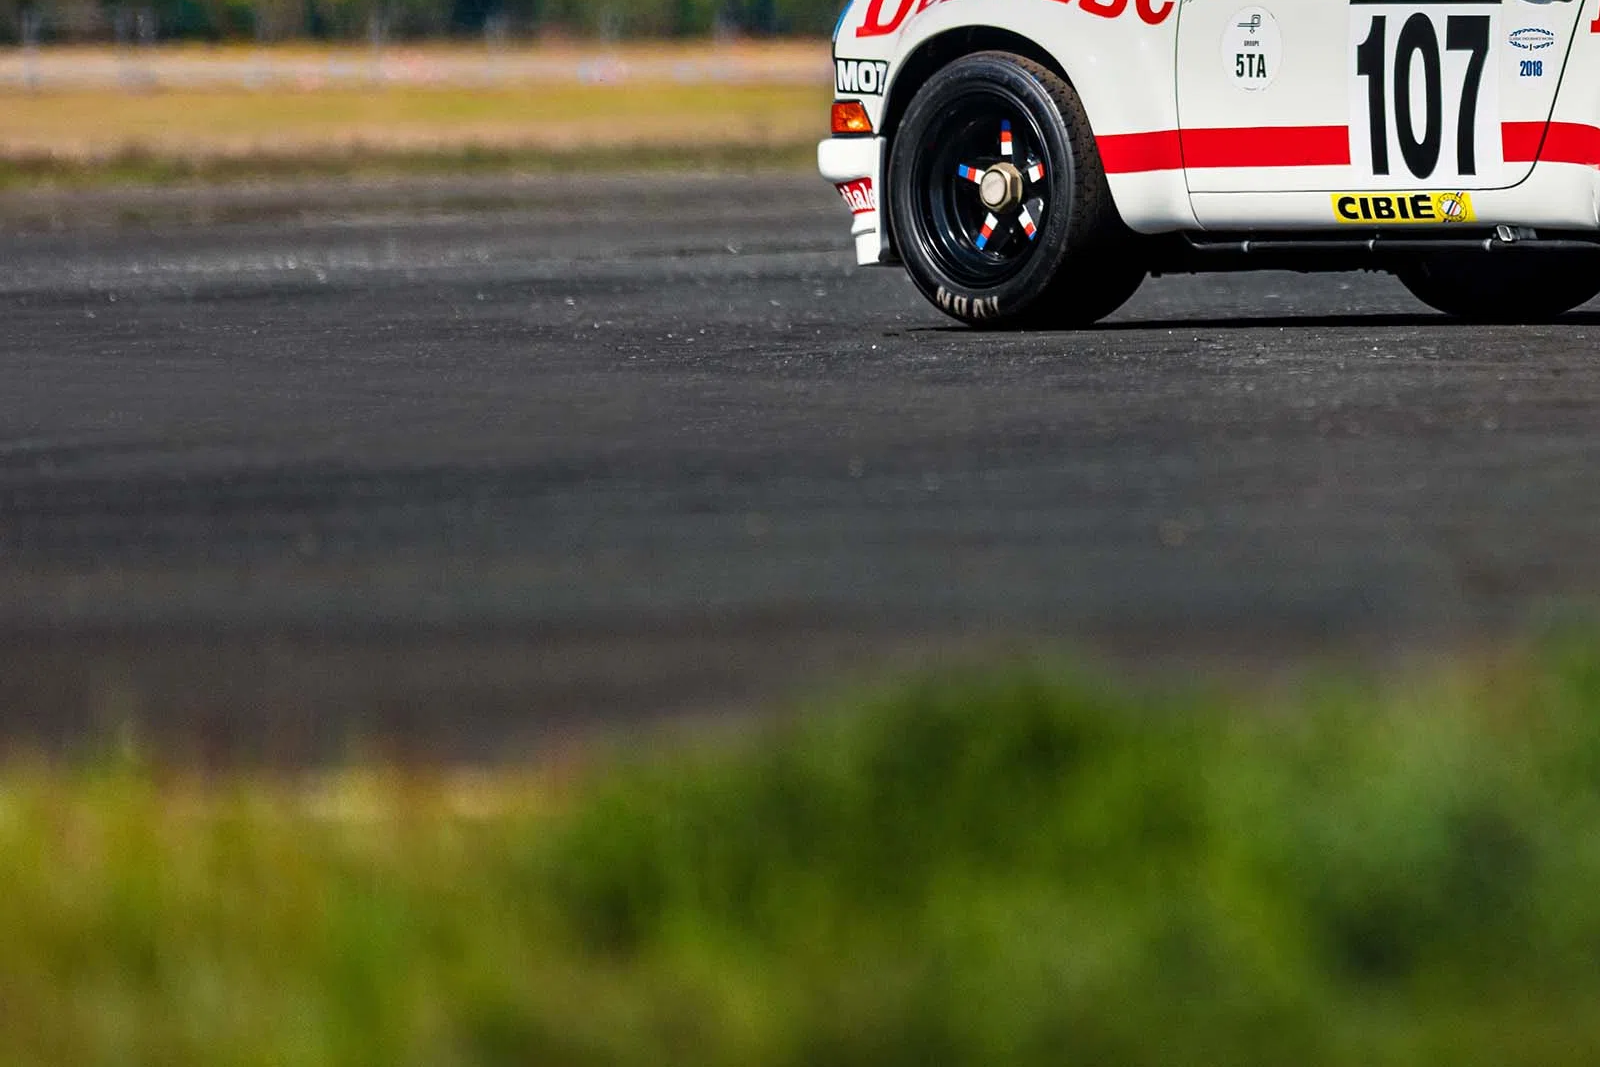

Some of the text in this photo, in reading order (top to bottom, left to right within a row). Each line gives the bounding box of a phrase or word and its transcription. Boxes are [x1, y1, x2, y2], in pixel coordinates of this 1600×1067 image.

[1235, 53, 1267, 78] 5TA
[1519, 60, 1543, 77] 2018
[1356, 12, 1491, 179] 107
